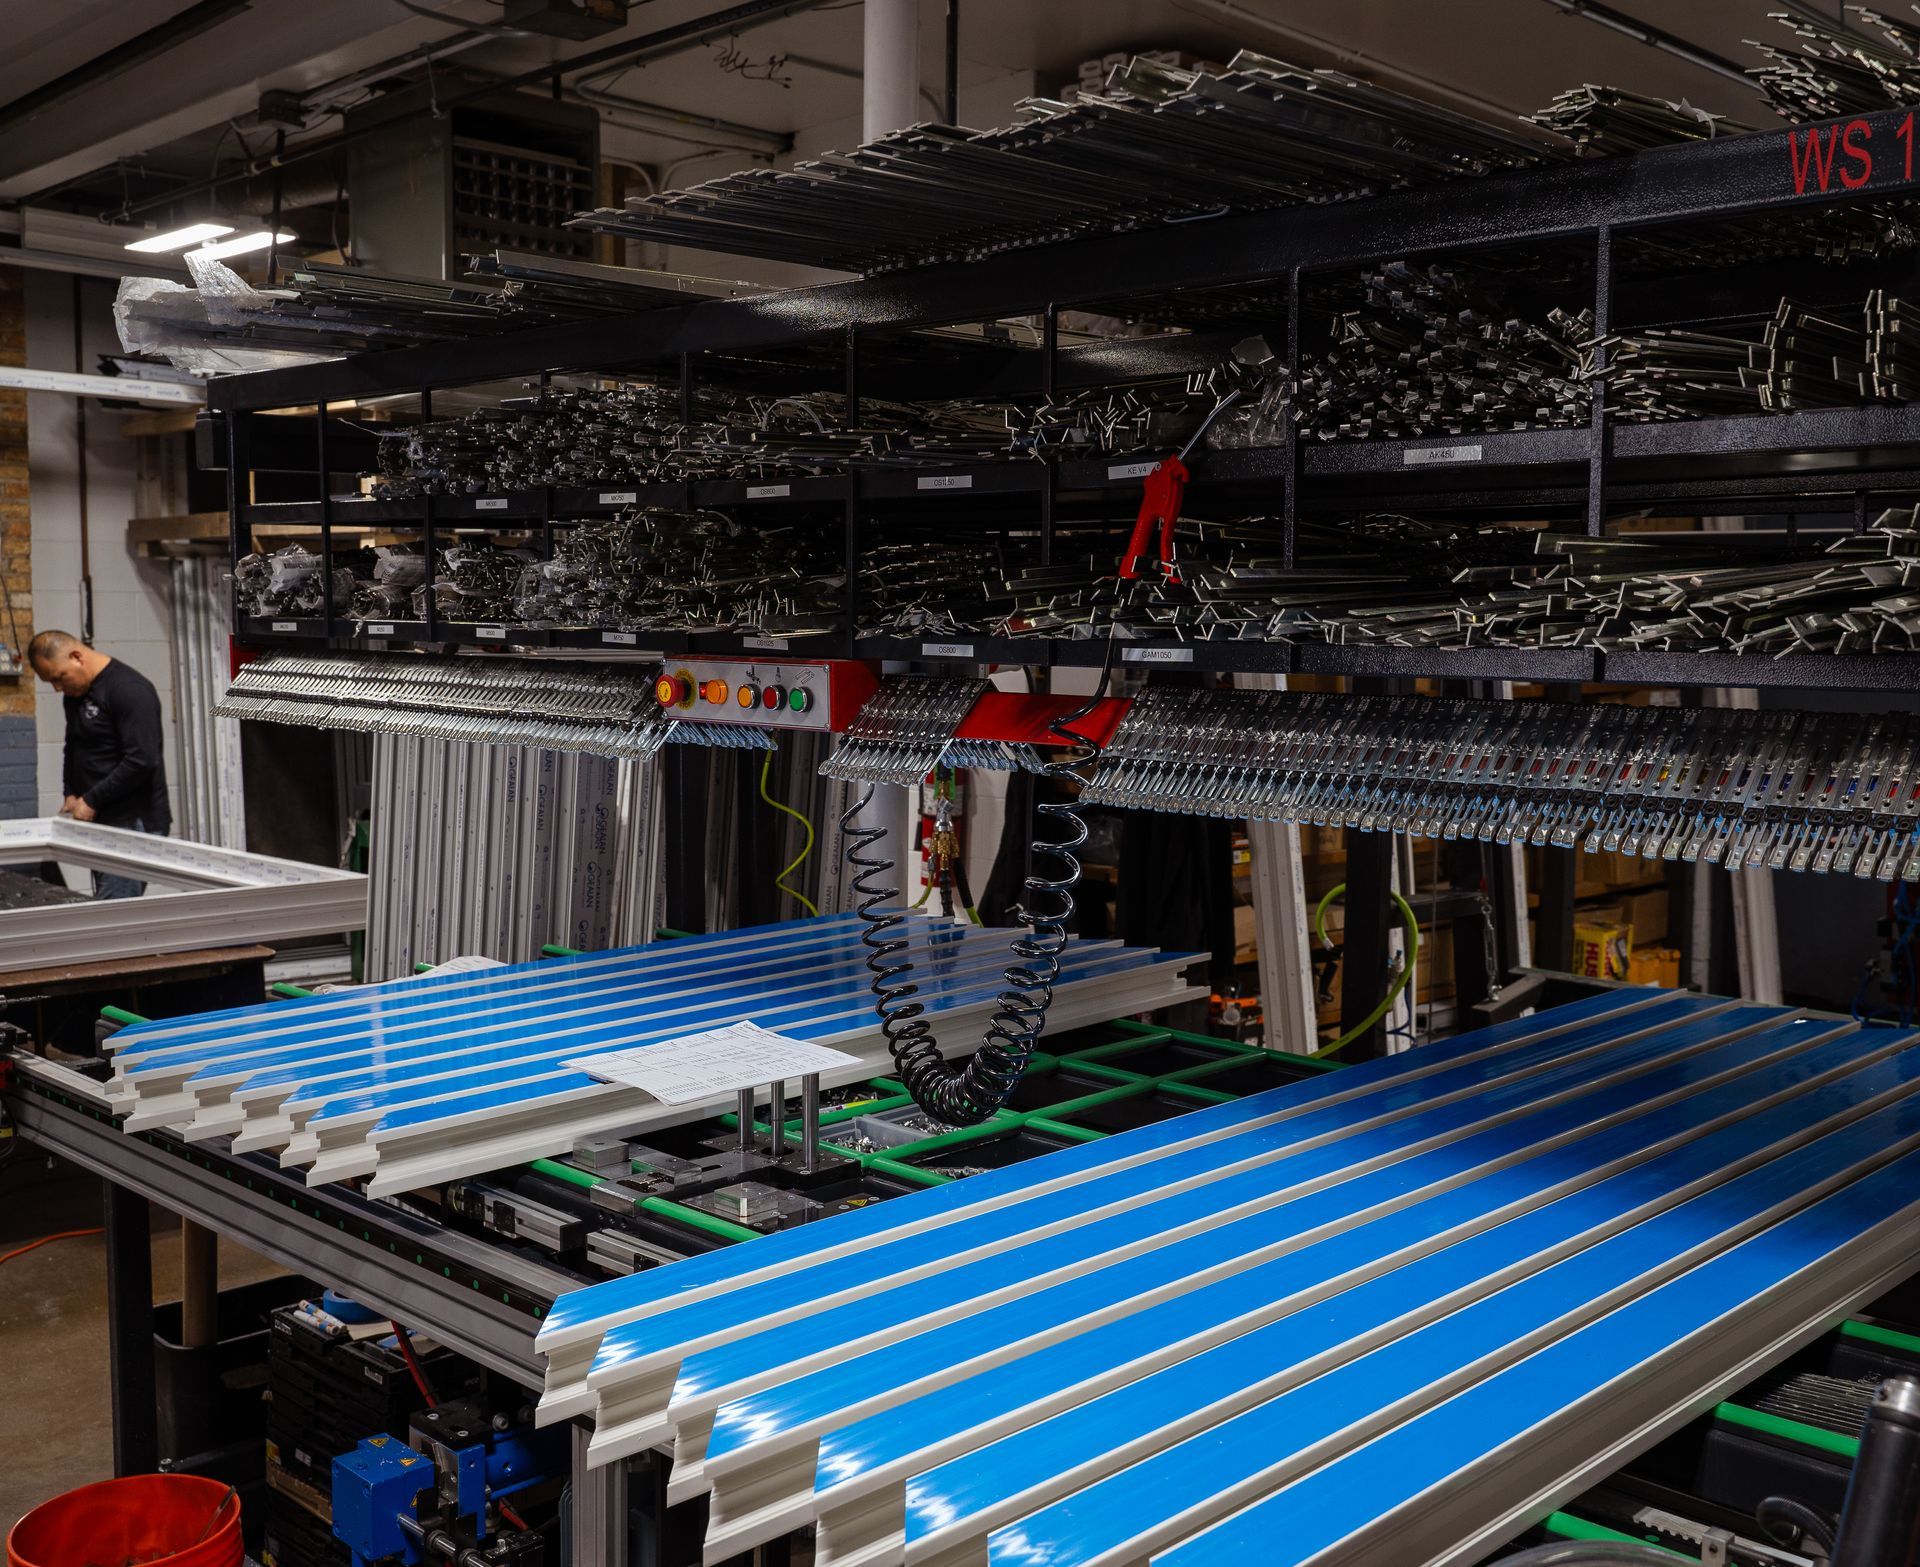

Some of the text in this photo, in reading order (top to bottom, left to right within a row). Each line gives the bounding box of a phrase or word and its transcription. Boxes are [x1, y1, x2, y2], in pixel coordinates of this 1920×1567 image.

[1788, 112, 1914, 195] WS 1
[1128, 466, 1147, 475] KE V4
[1141, 650, 1172, 659] GAM1050
